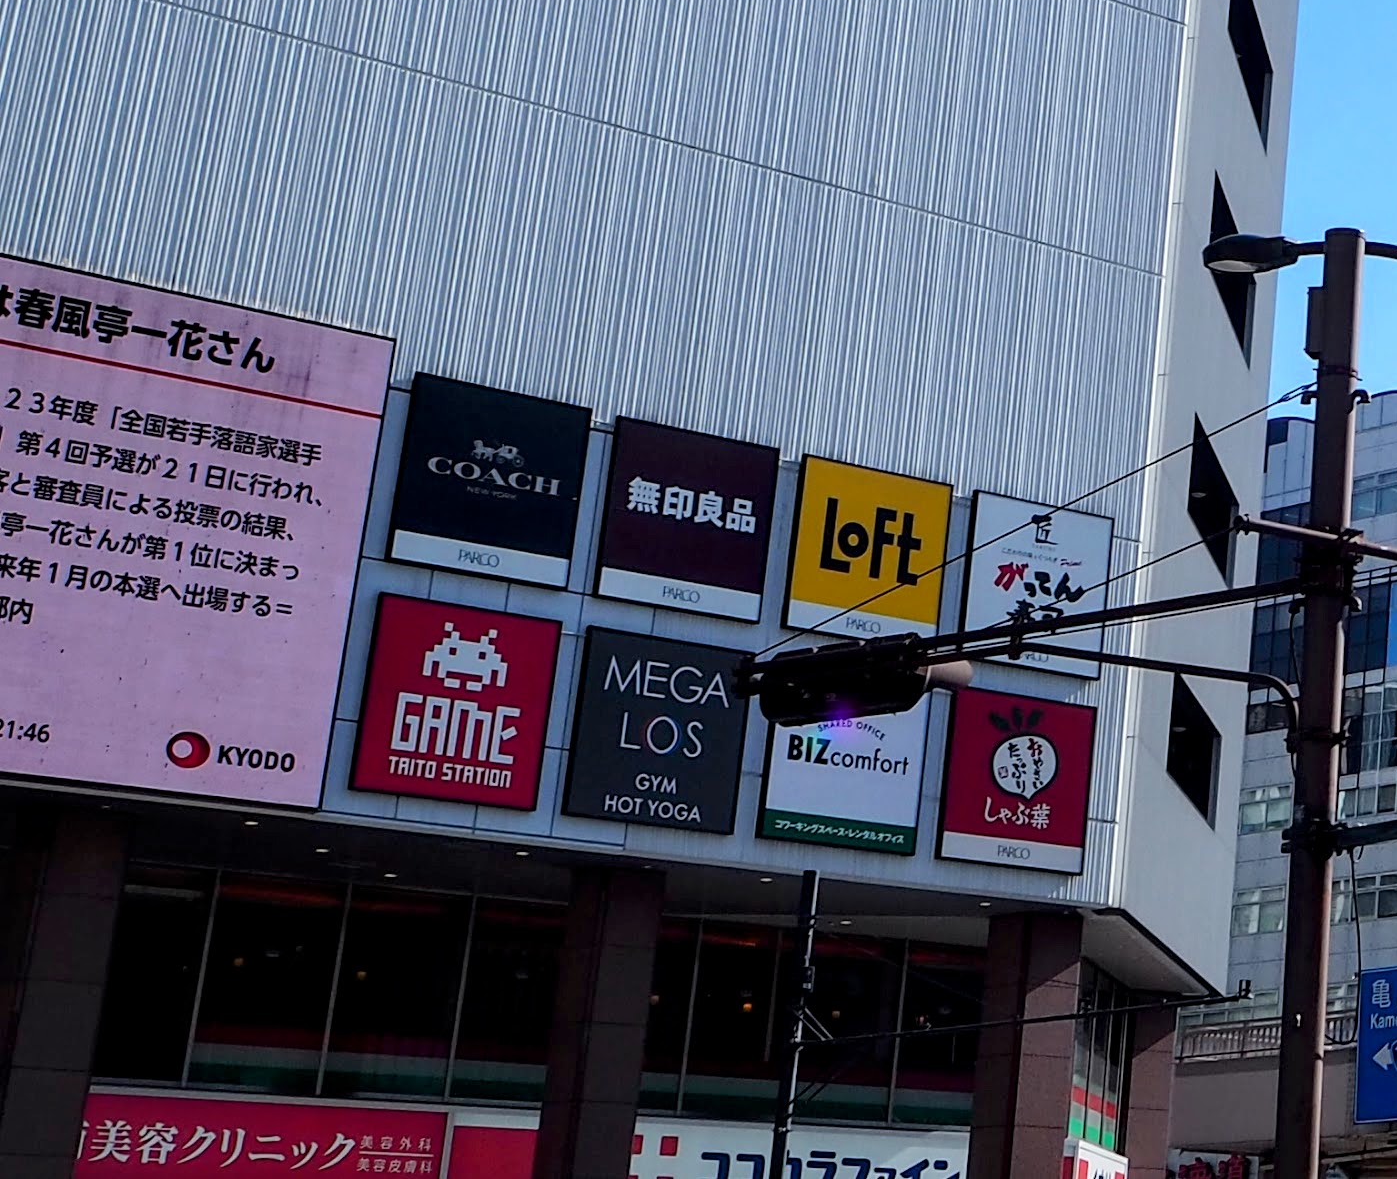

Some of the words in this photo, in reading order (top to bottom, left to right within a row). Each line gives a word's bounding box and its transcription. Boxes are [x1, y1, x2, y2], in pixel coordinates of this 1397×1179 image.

[427, 456, 561, 497] COACH
[466, 485, 489, 497] NEW
[492, 489, 518, 501] YORK
[626, 476, 756, 533] 無印良品
[458, 548, 500, 568] PARCO
[662, 585, 700, 604] PARCO
[994, 561, 1086, 602] がってん
[845, 617, 881, 634] PARCO
[604, 655, 729, 708] MEGA
[390, 692, 521, 765] GAME
[620, 712, 704, 758] LOS
[856, 721, 886, 741] OFFICE
[216, 744, 296, 773] KYODO
[787, 734, 909, 775] BIZcomfort
[1008, 742, 1027, 793] たっぷり
[389, 756, 436, 779] TAITO
[441, 763, 512, 788] STATION
[635, 773, 677, 794] GYM
[604, 795, 643, 815] HOT
[647, 798, 701, 823] YOGA
[984, 796, 1051, 830] しゃぶ葉
[997, 845, 1031, 860] PARCO
[360, 1135, 431, 1151] 美容外科
[356, 1157, 432, 1173] 美容皮膚科
